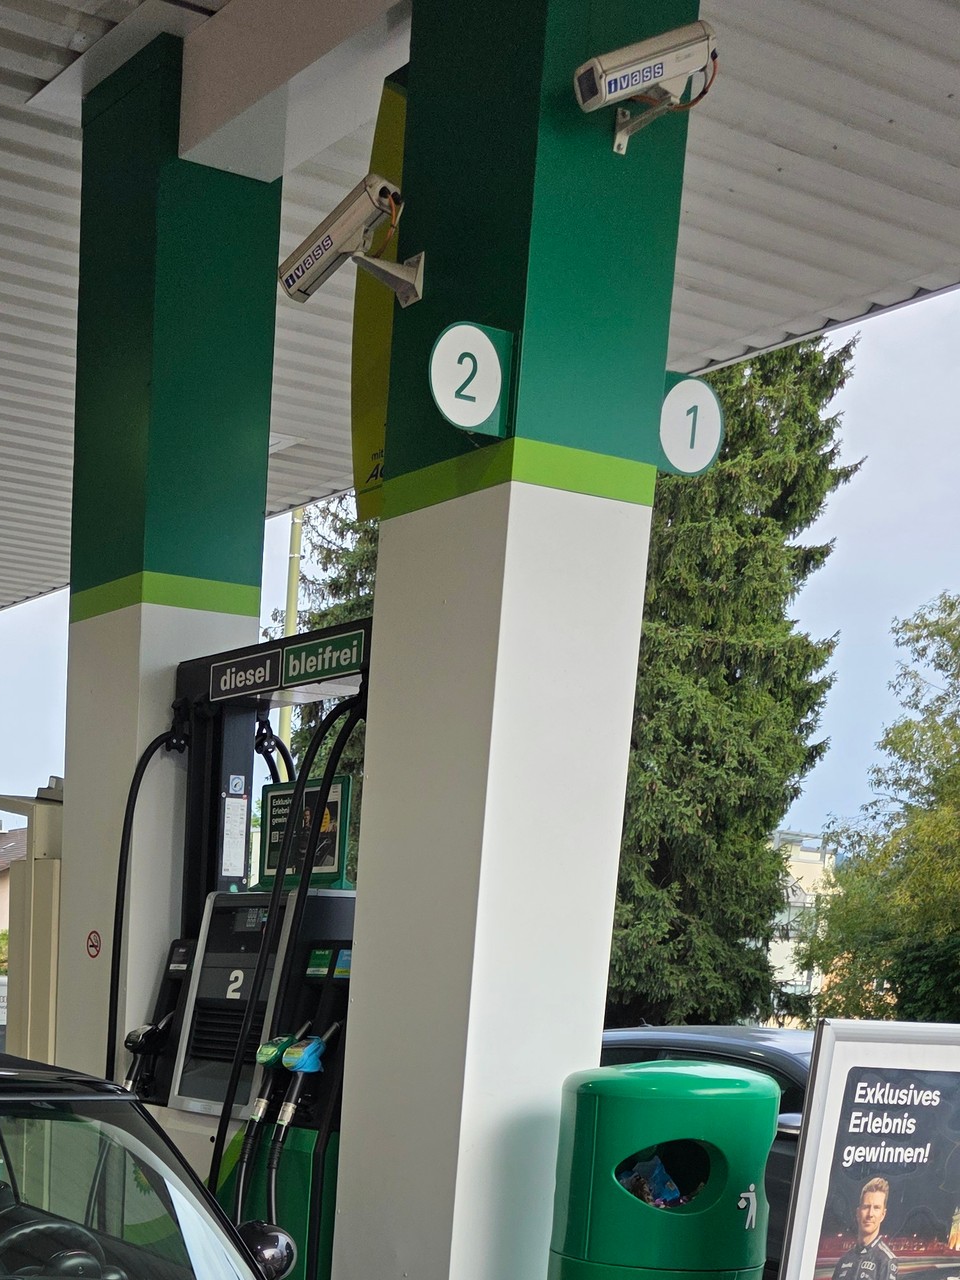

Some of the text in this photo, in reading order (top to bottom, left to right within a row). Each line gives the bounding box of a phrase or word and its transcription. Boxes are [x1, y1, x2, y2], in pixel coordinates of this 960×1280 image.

[609, 63, 663, 93] ivass
[286, 236, 332, 287] ivass
[454, 351, 478, 403] 2
[686, 405, 698, 450] 1
[288, 640, 358, 677] bleifrei
[220, 659, 271, 691] diesel
[226, 969, 244, 999] 2
[854, 1082, 941, 1106] Exklusives
[848, 1112, 917, 1134] Erlebnis
[842, 1141, 931, 1168] gewinnen!
